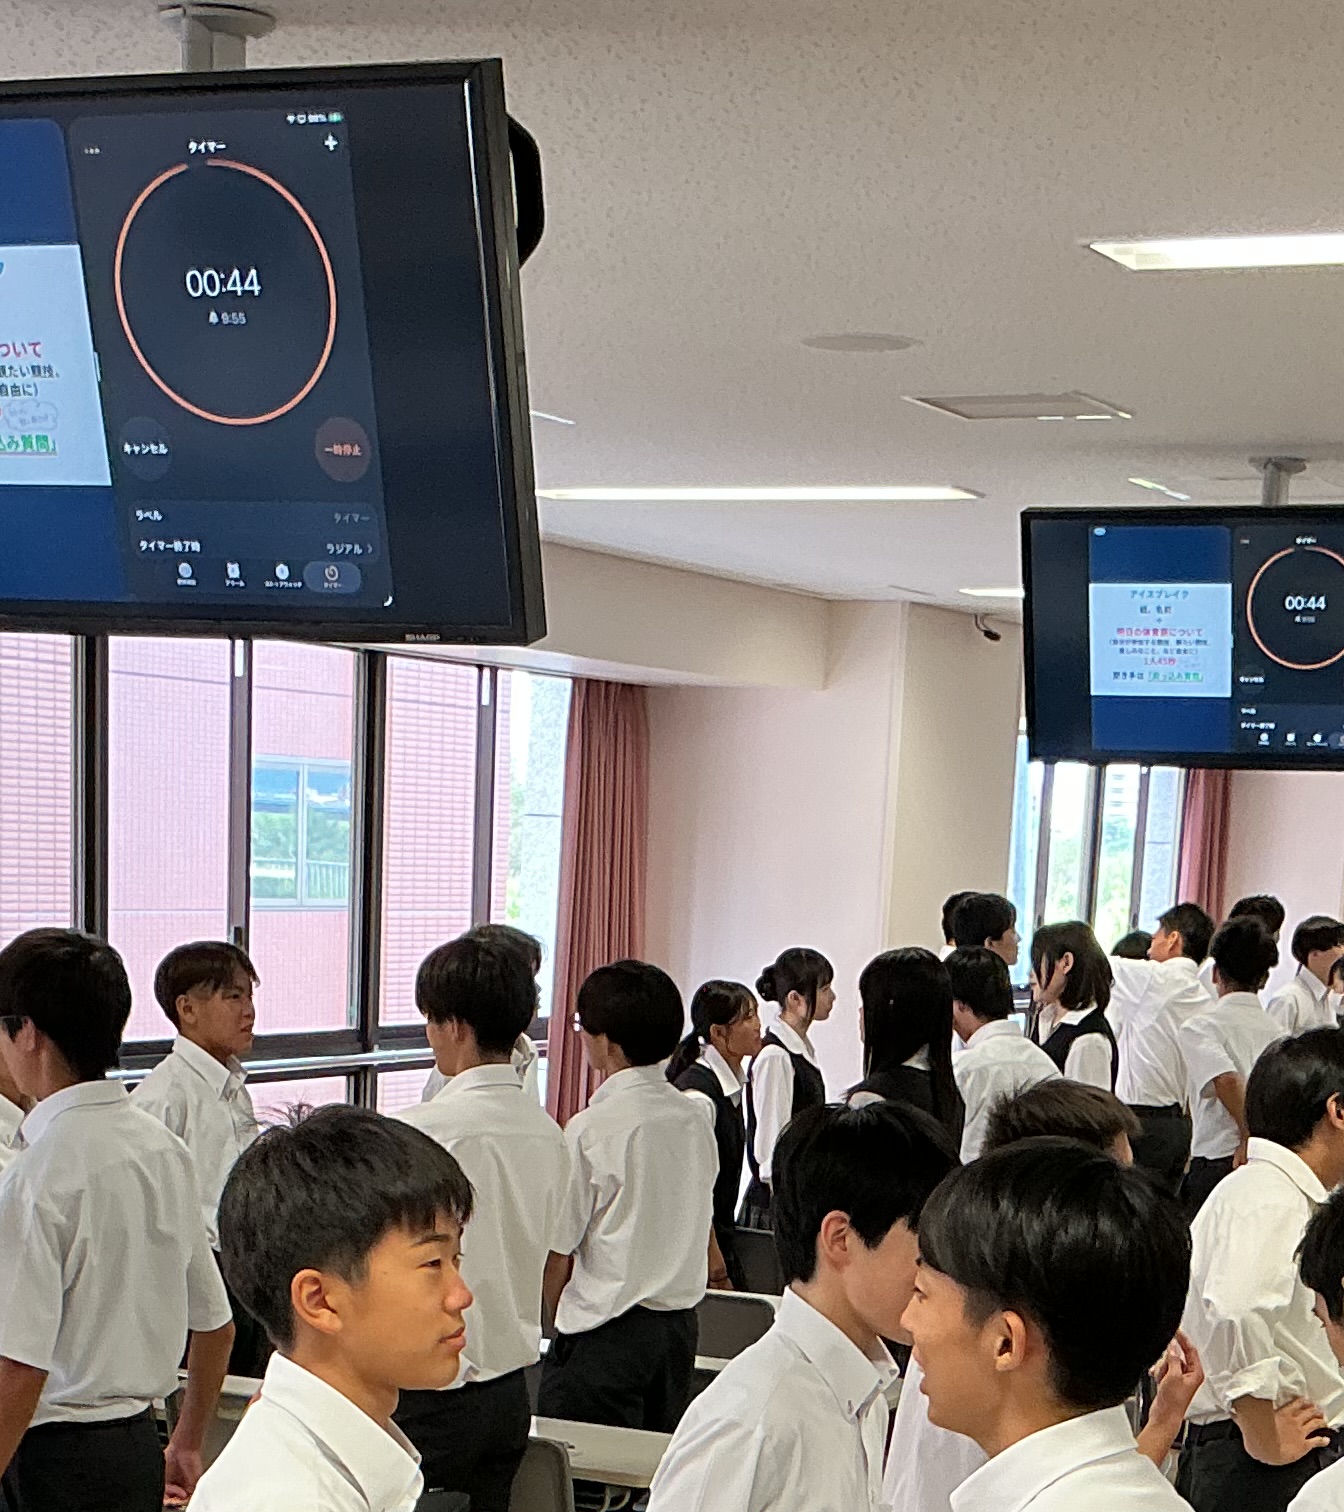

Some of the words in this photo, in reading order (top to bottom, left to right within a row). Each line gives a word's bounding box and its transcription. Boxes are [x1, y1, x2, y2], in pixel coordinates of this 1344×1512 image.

[187, 140, 228, 154] タイマー
[185, 267, 262, 298] 00:44
[221, 311, 247, 325] 9:55
[122, 441, 169, 456] キャンセル
[135, 509, 164, 522] ラベル
[333, 512, 371, 525] タイマー
[325, 542, 364, 556] ラジアル
[1284, 595, 1327, 610] 00:44
